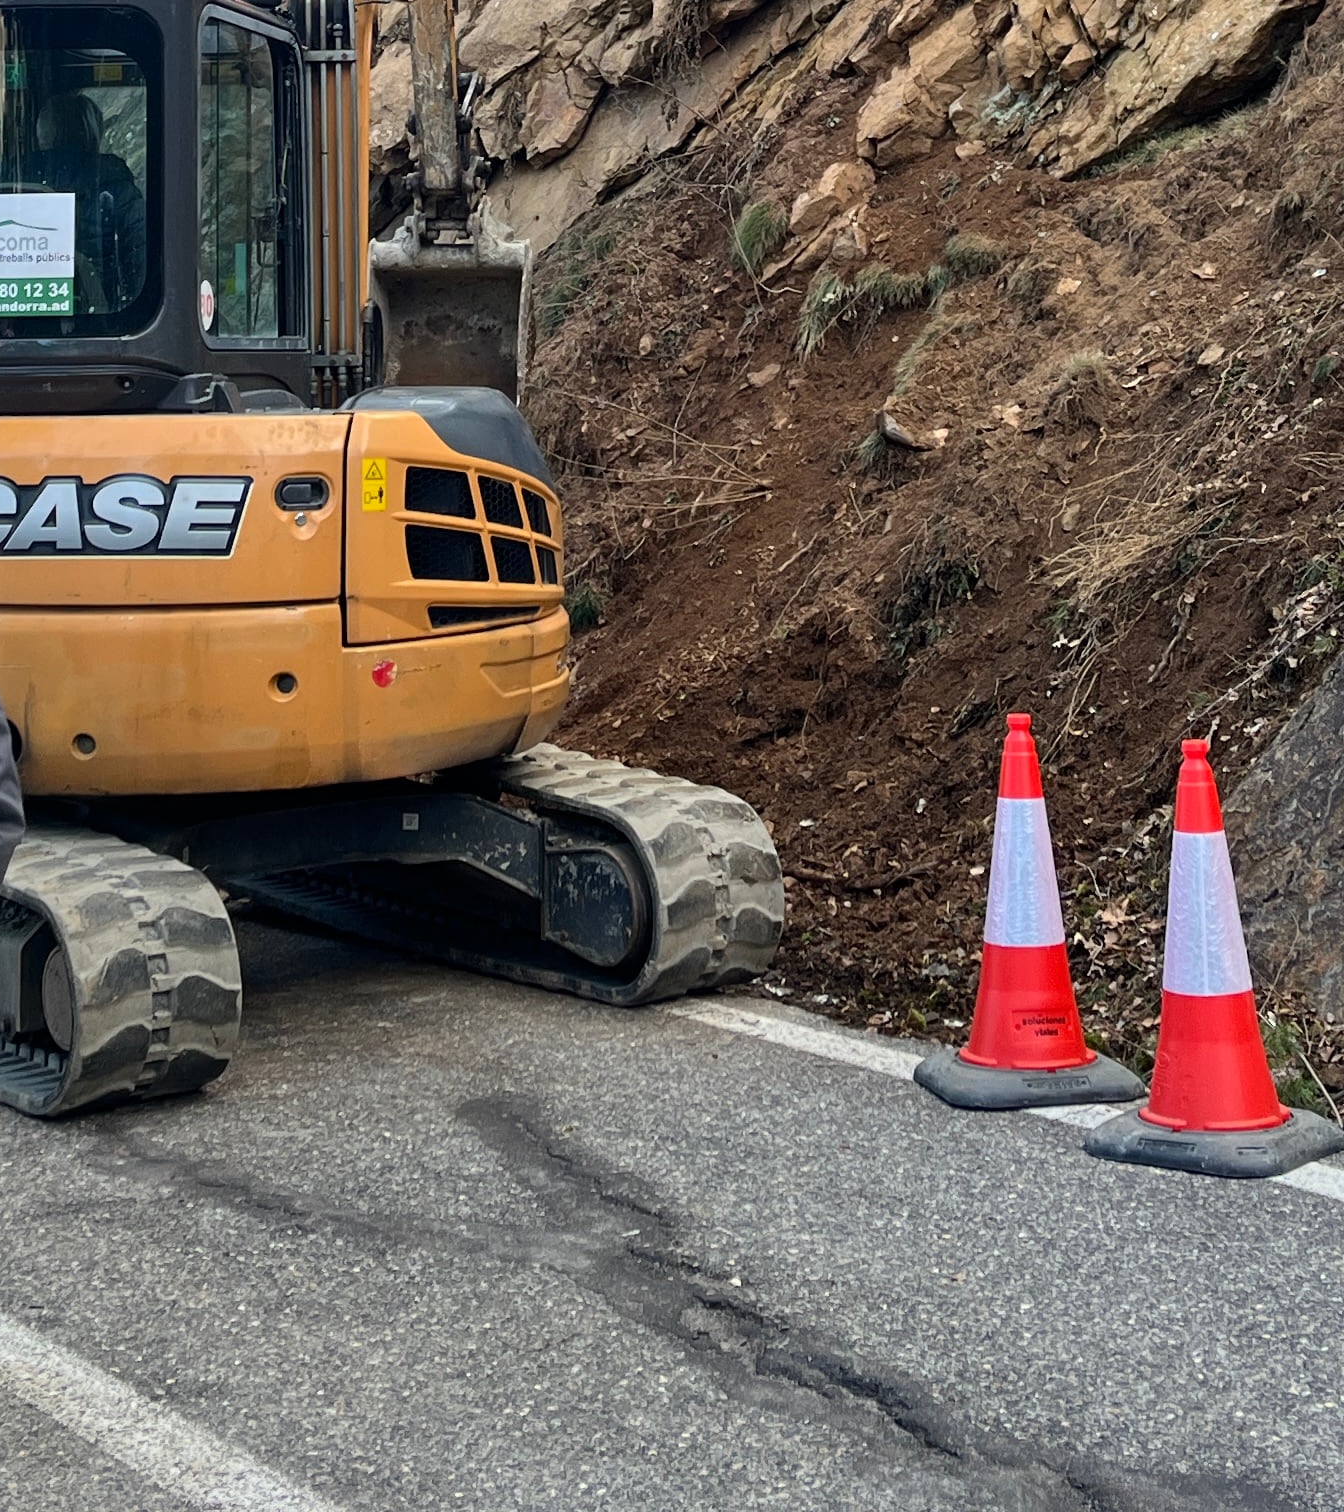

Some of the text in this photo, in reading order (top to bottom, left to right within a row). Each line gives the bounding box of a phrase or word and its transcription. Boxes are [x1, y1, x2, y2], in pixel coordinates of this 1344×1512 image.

[0, 253, 33, 263] treballs
[0, 283, 18, 298] 80
[24, 283, 43, 298] 12
[48, 282, 69, 297] 34
[1022, 1016, 1066, 1026] soluciones
[1035, 1028, 1059, 1037] viales
